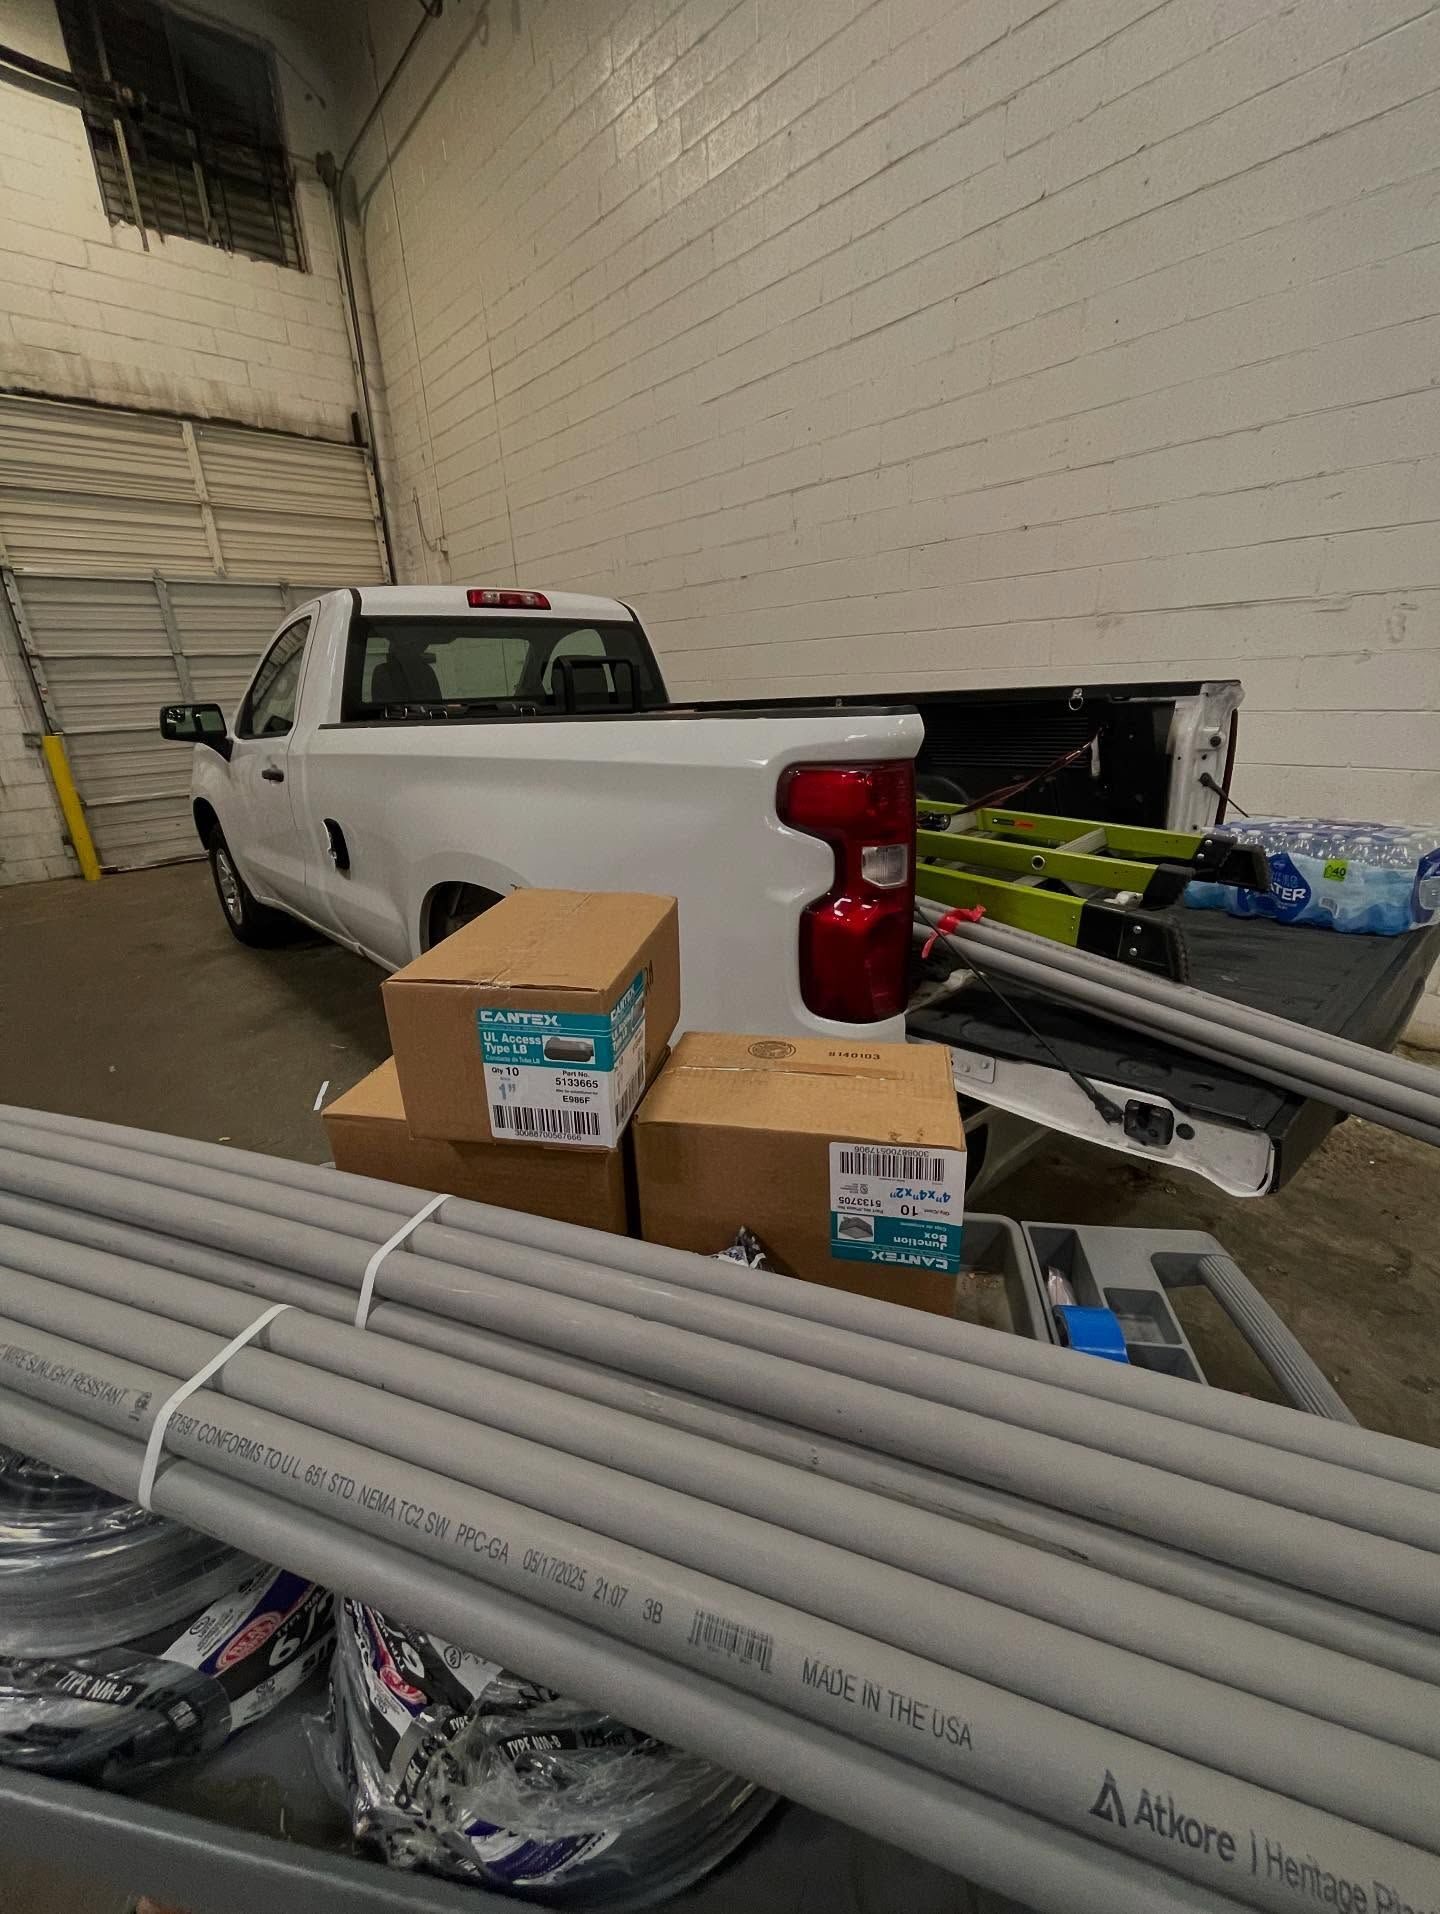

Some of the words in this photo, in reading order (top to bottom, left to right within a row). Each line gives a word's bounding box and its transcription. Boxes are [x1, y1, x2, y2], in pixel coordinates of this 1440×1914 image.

[480, 1010, 557, 1026] CANTEX
[482, 1031, 498, 1044] UL
[501, 1032, 541, 1045] Access
[484, 1042, 510, 1055] Type
[512, 1043, 528, 1054] LB
[491, 1067, 504, 1076] Qty
[505, 1066, 520, 1077] 10
[562, 1070, 577, 1078] Part
[555, 1077, 599, 1089] 5133665
[854, 1145, 929, 1158] 30088700517906
[838, 1196, 882, 1207] 5133705
[900, 1205, 919, 1217] 10
[893, 1236, 948, 1250] Junction
[924, 1232, 948, 1242] Box
[870, 1250, 949, 1270] CANTEX
[26, 1355, 73, 1386] SUNLIGHT
[72, 1371, 129, 1406] RESISTANT
[197, 1422, 264, 1462] CONFORMS
[304, 1464, 326, 1489] 651
[358, 1484, 397, 1520] NEMA
[397, 1500, 425, 1530] TC2
[424, 1511, 452, 1539] SW
[454, 1522, 510, 1565] PPC-GA
[522, 1548, 587, 1593] 05/17/2025
[592, 1576, 629, 1610] 21:07
[642, 1597, 664, 1625] 3B
[801, 1656, 857, 1704] MADE
[860, 1678, 883, 1714] IN
[887, 1688, 927, 1732] THE
[931, 1706, 976, 1752] USA
[1132, 1786, 1238, 1863] Atkore
[55, 1670, 93, 1695] TYPE
[86, 1679, 133, 1702] NM-B
